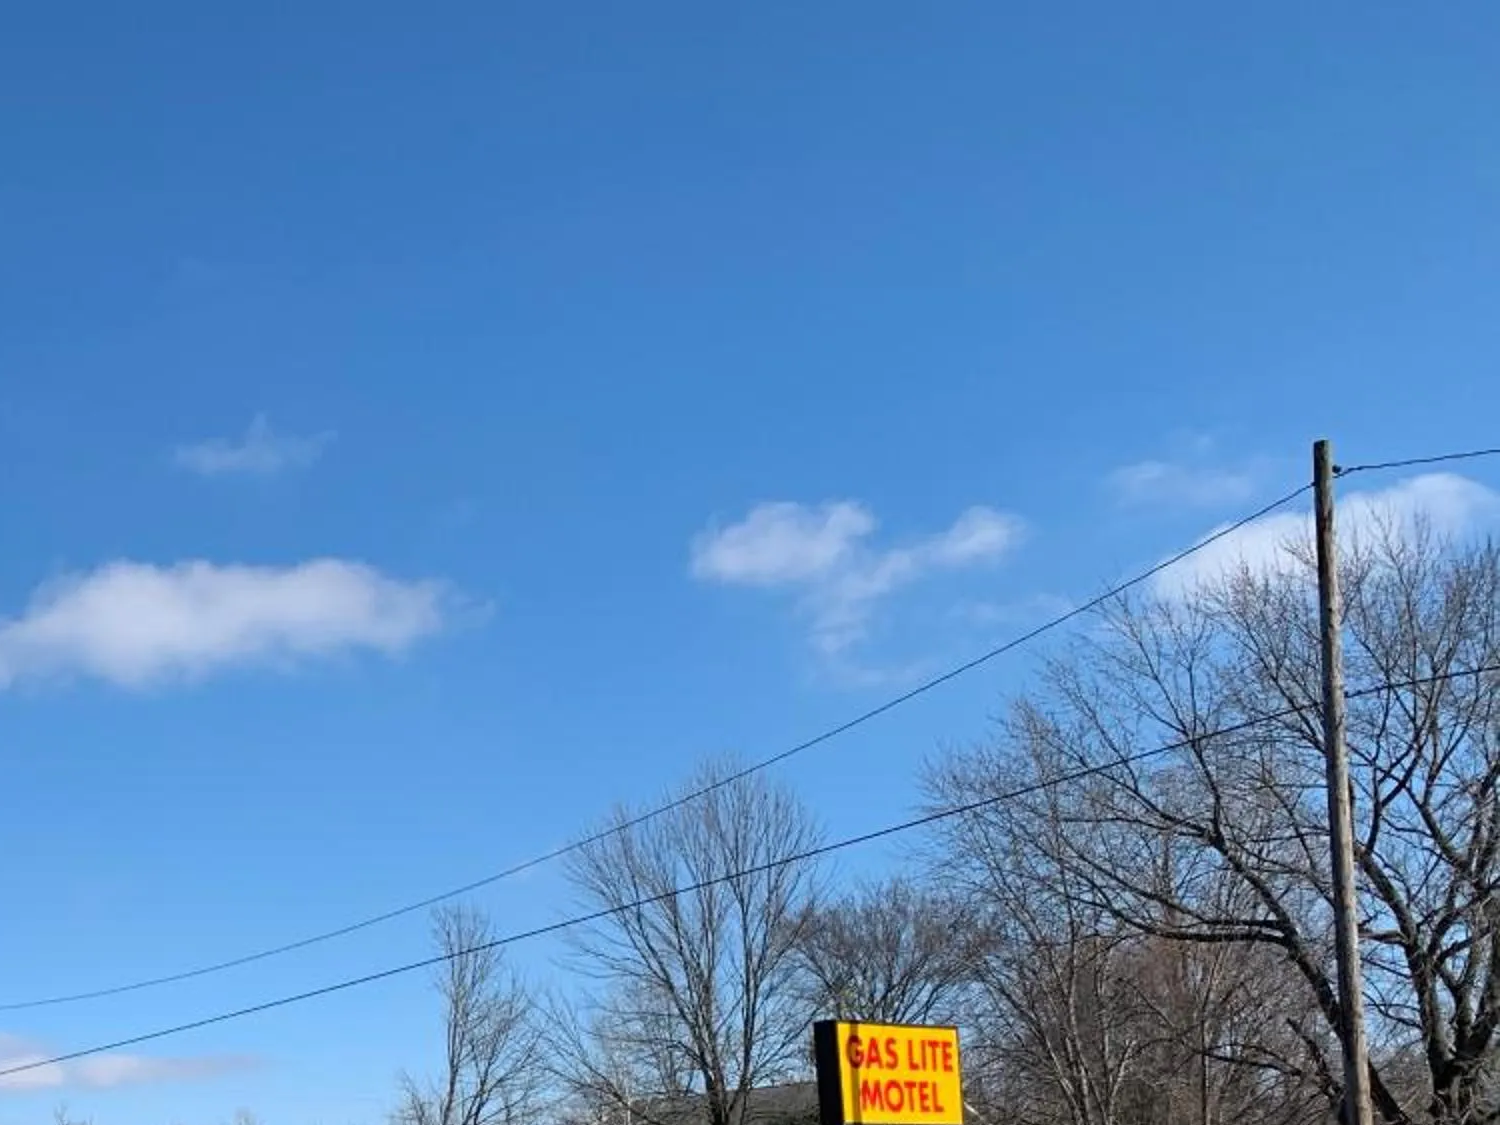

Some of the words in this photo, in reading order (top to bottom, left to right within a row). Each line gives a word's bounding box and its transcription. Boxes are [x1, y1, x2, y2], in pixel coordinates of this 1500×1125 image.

[846, 1035, 899, 1070] GAS
[907, 1039, 954, 1073] LITE
[860, 1079, 945, 1113] MOTEL
